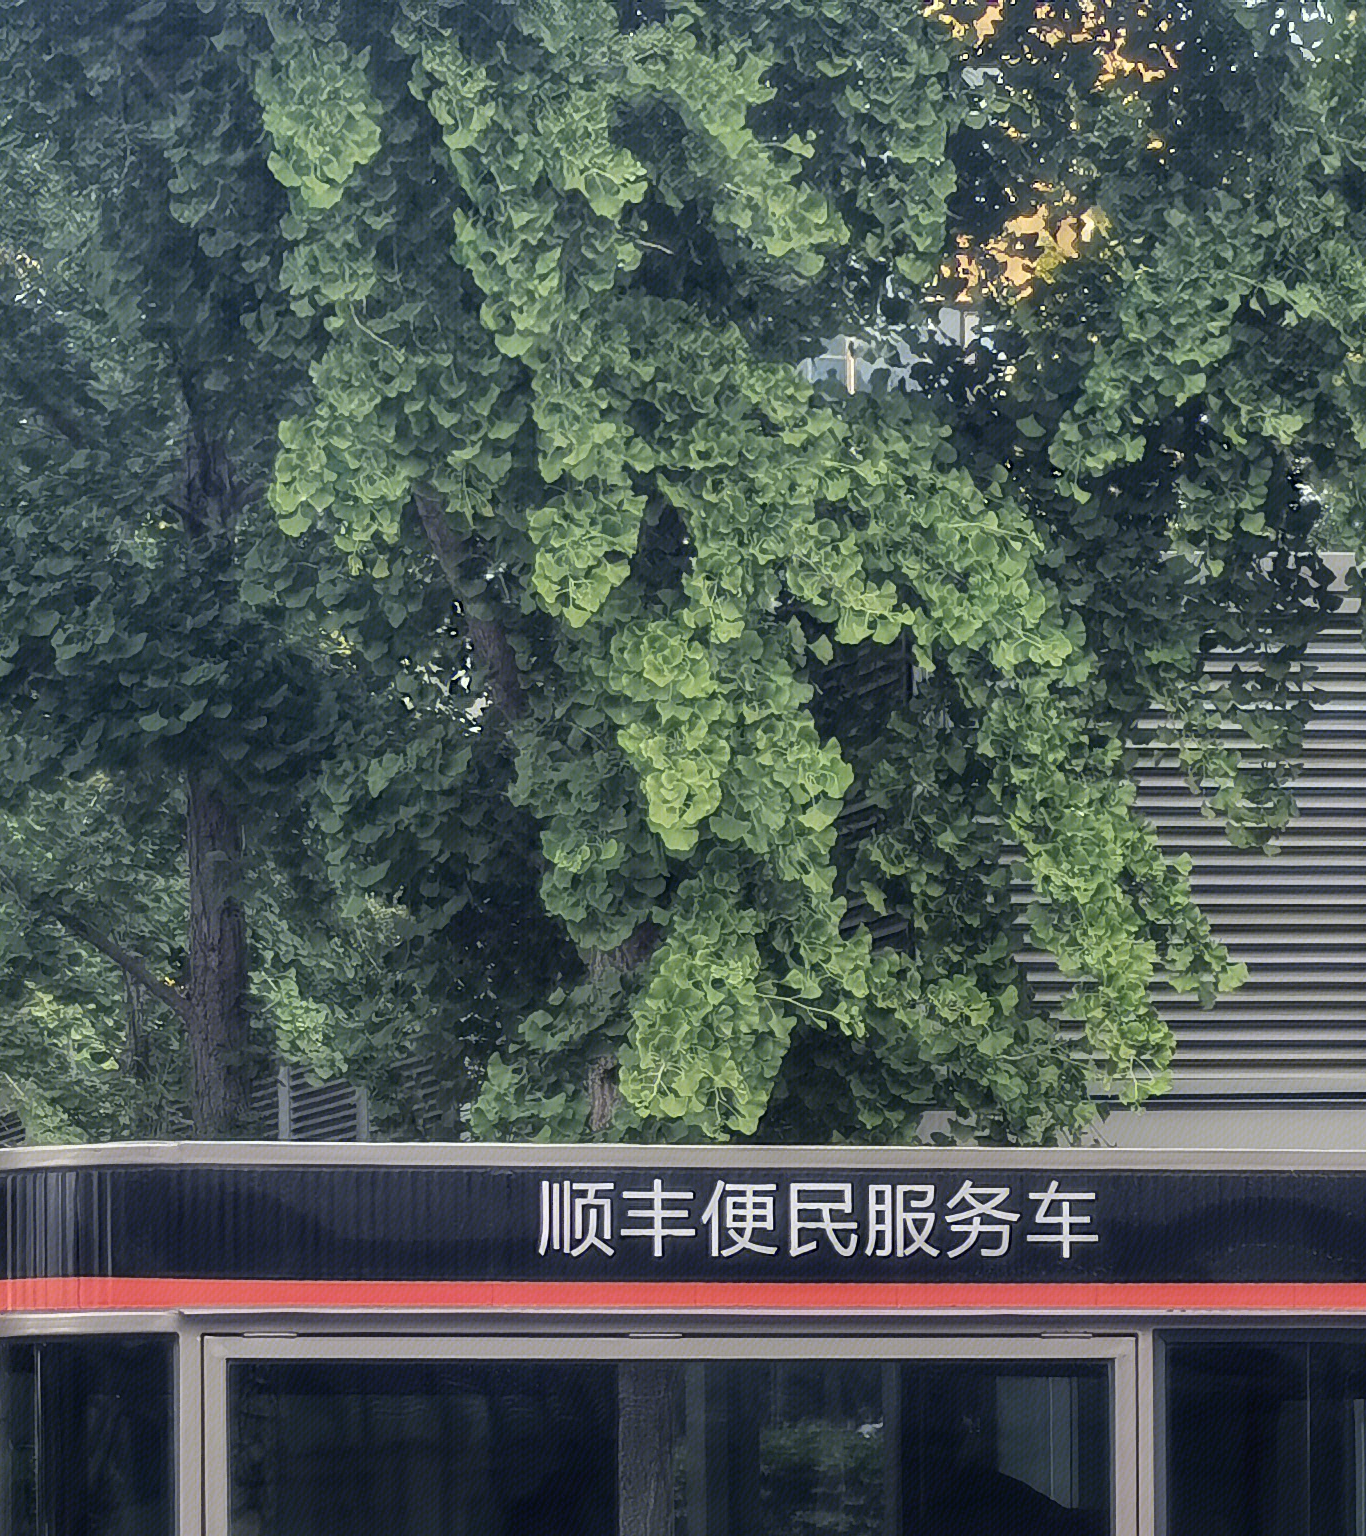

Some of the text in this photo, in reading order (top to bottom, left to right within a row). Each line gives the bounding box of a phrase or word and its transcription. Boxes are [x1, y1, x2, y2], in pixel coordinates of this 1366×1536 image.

[538, 1177, 1100, 1260] 顺丰便民服务车
